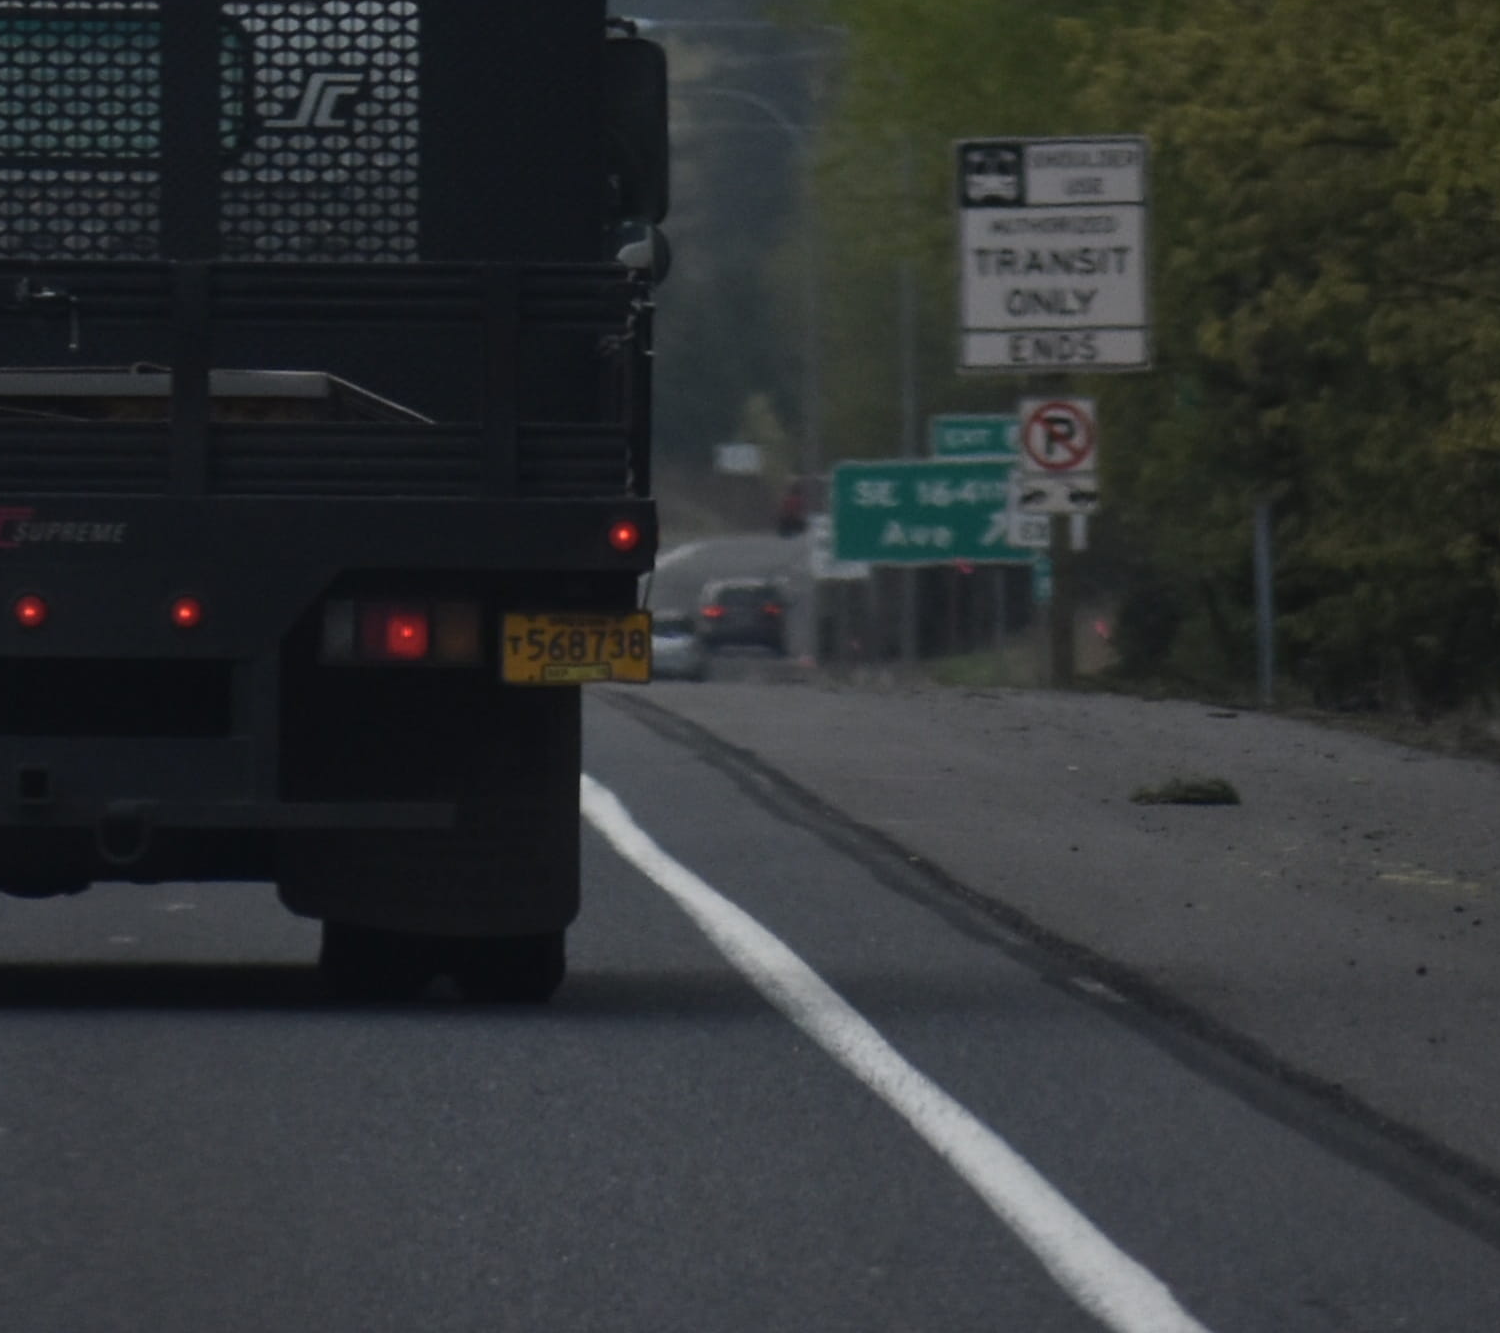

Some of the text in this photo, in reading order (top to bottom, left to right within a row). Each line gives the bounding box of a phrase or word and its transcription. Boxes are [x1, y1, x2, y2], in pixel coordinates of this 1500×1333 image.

[974, 245, 1131, 275] TRANSIT
[1006, 286, 1098, 317] ONLY
[1010, 333, 1097, 362] ENDS
[12, 520, 128, 543] SUPREME
[880, 520, 954, 548] Ave
